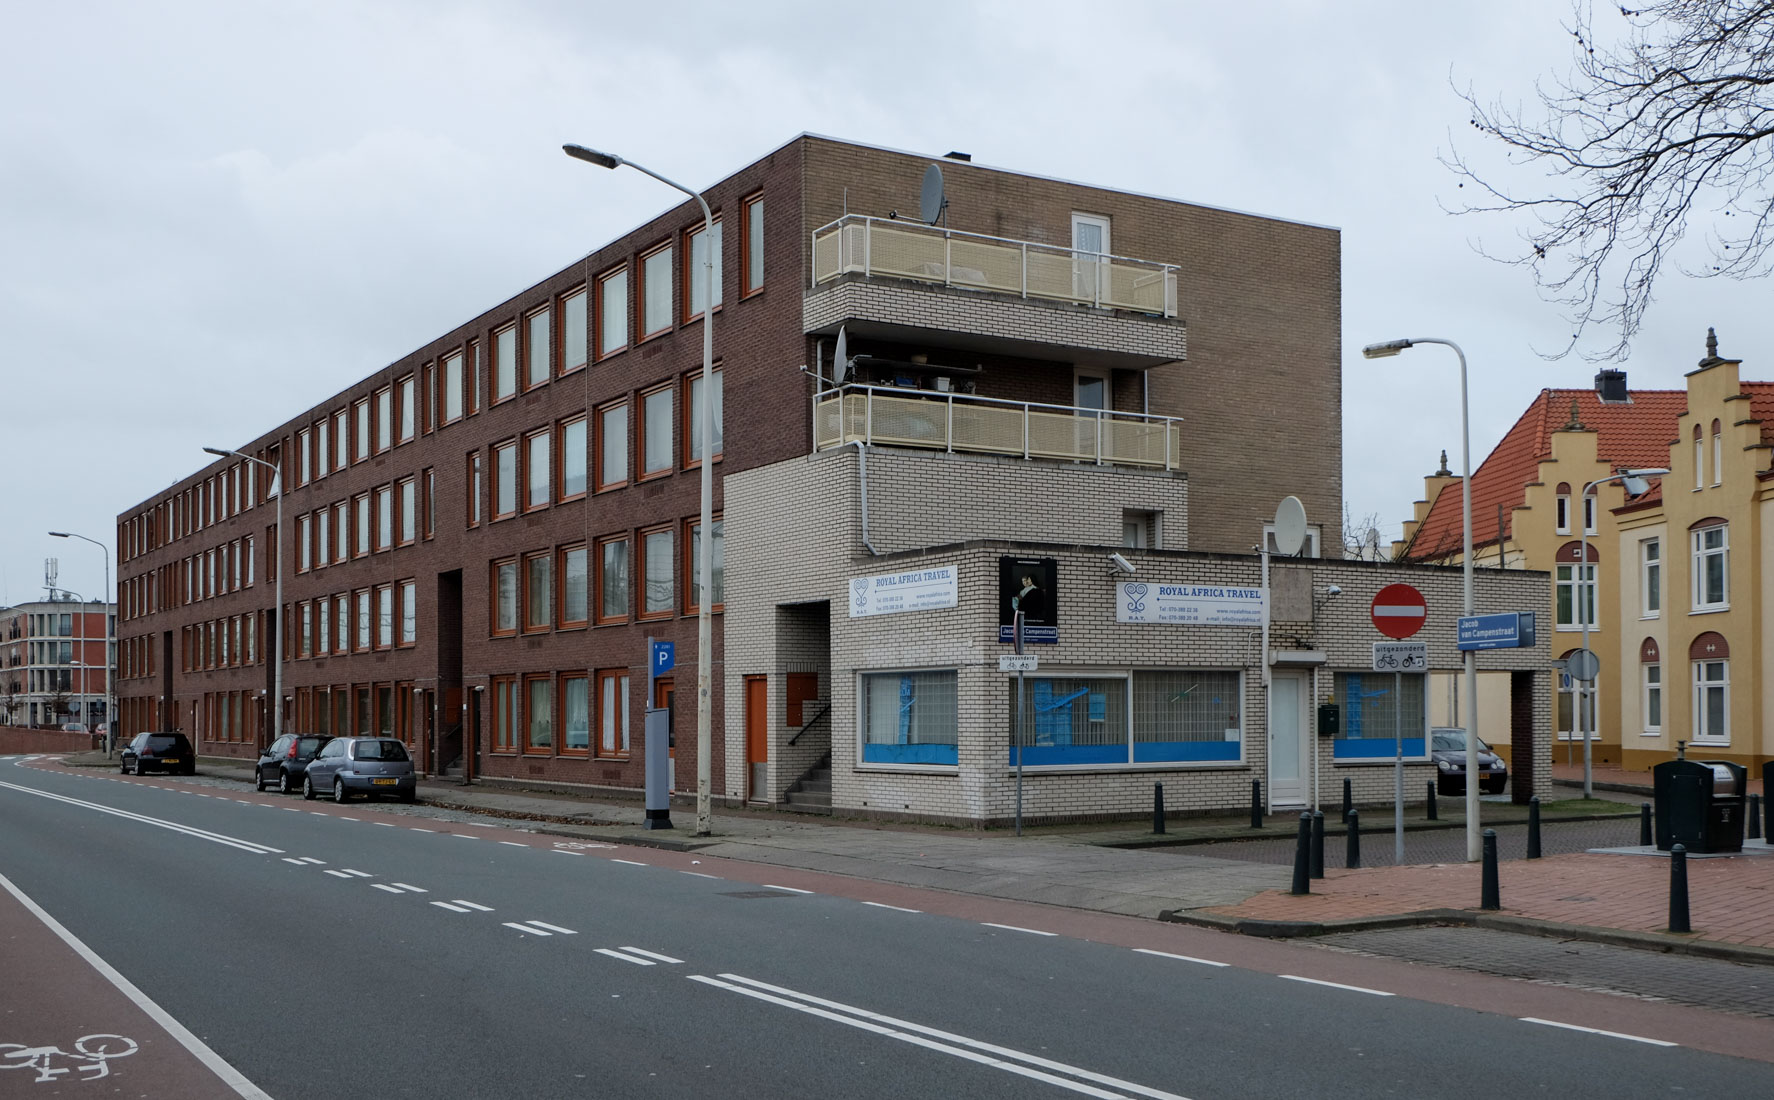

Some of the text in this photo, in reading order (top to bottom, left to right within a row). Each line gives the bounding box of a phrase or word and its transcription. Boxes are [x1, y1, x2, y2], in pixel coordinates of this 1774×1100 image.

[876, 570, 950, 587] ROYAL AFRICA TRAVEL
[1160, 587, 1261, 598] ROYAL AFRICA TRAVEL
[1461, 620, 1478, 628] Jacob
[1473, 627, 1514, 639] Campenstraat
[1376, 645, 1424, 654] uitgezonderd
[660, 652, 668, 666] P
